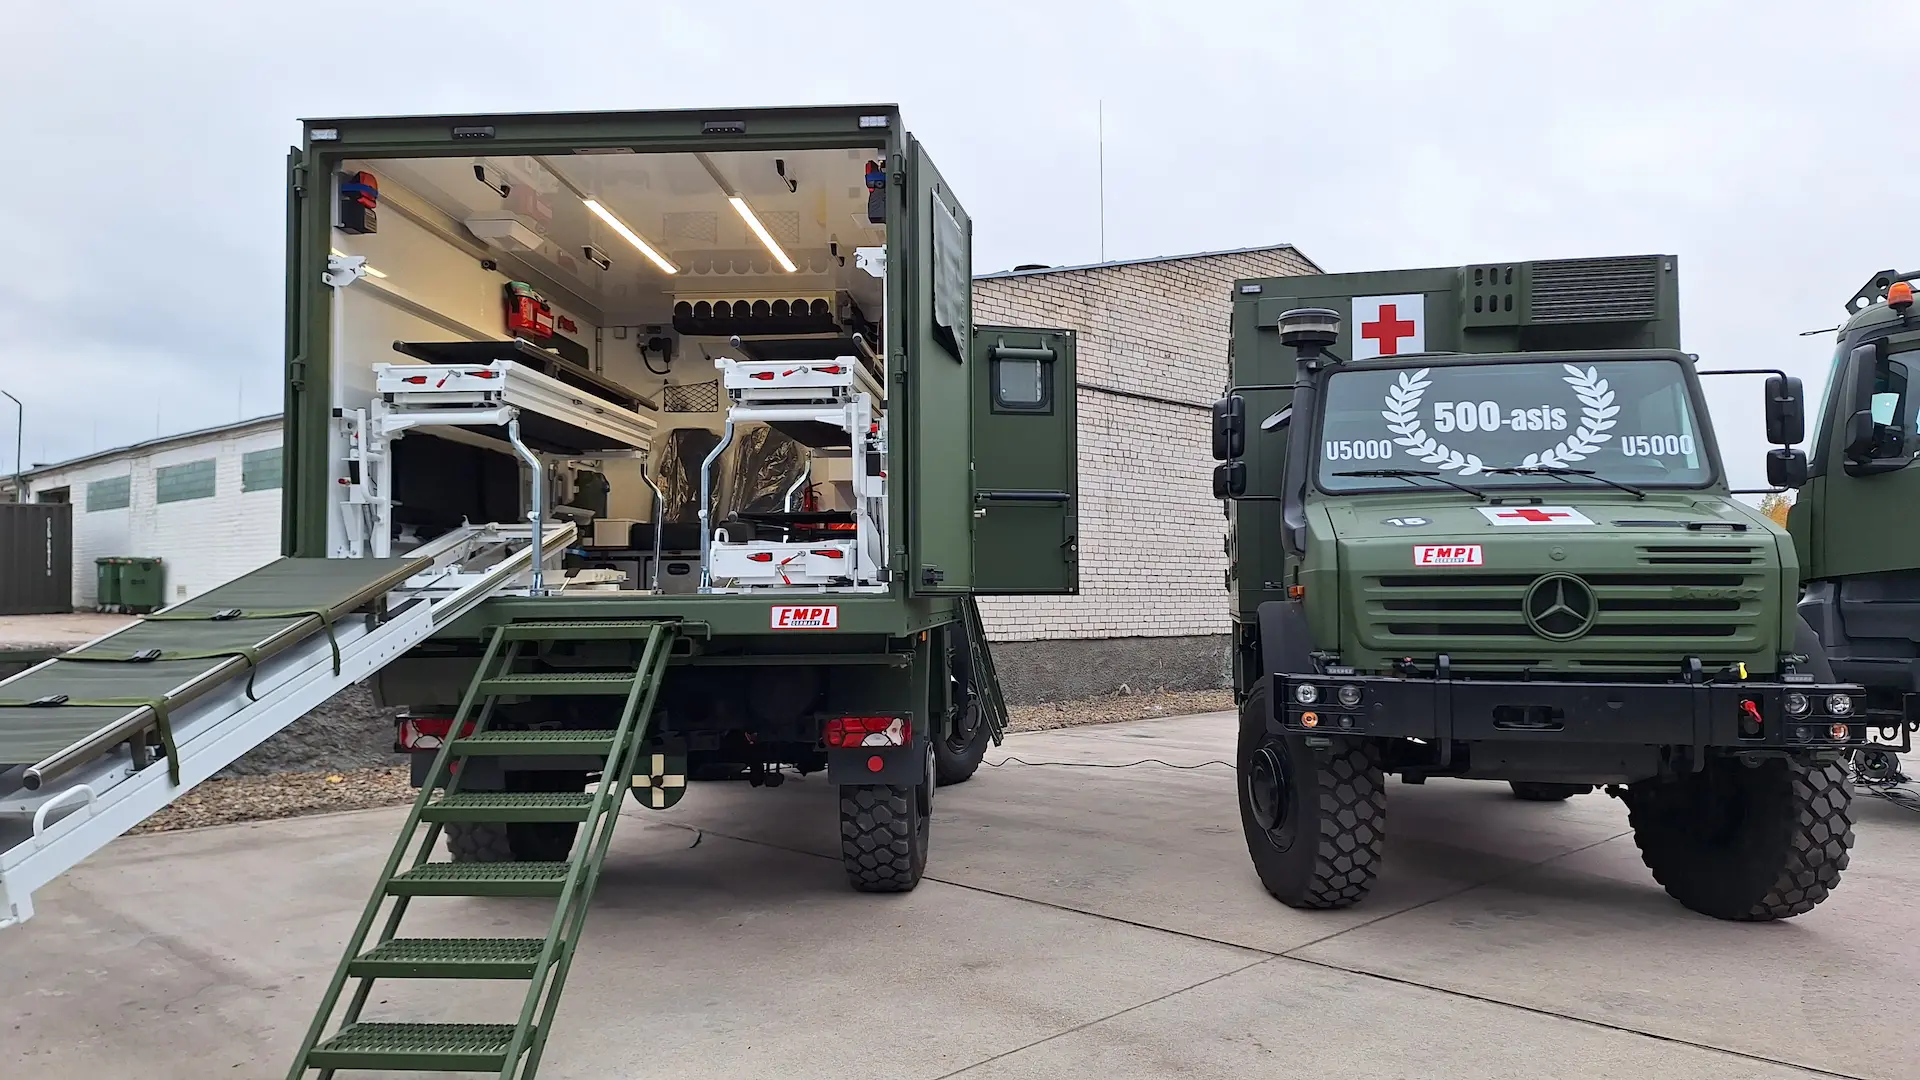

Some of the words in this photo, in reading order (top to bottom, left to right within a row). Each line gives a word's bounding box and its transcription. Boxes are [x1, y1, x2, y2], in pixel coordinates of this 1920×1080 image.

[1434, 400, 1568, 433] 500-asis
[1326, 439, 1393, 461] U5000
[1621, 434, 1694, 457] U5000
[1386, 517, 1427, 526] 15
[1422, 547, 1475, 563] EMPL
[778, 608, 831, 626] EMPL
